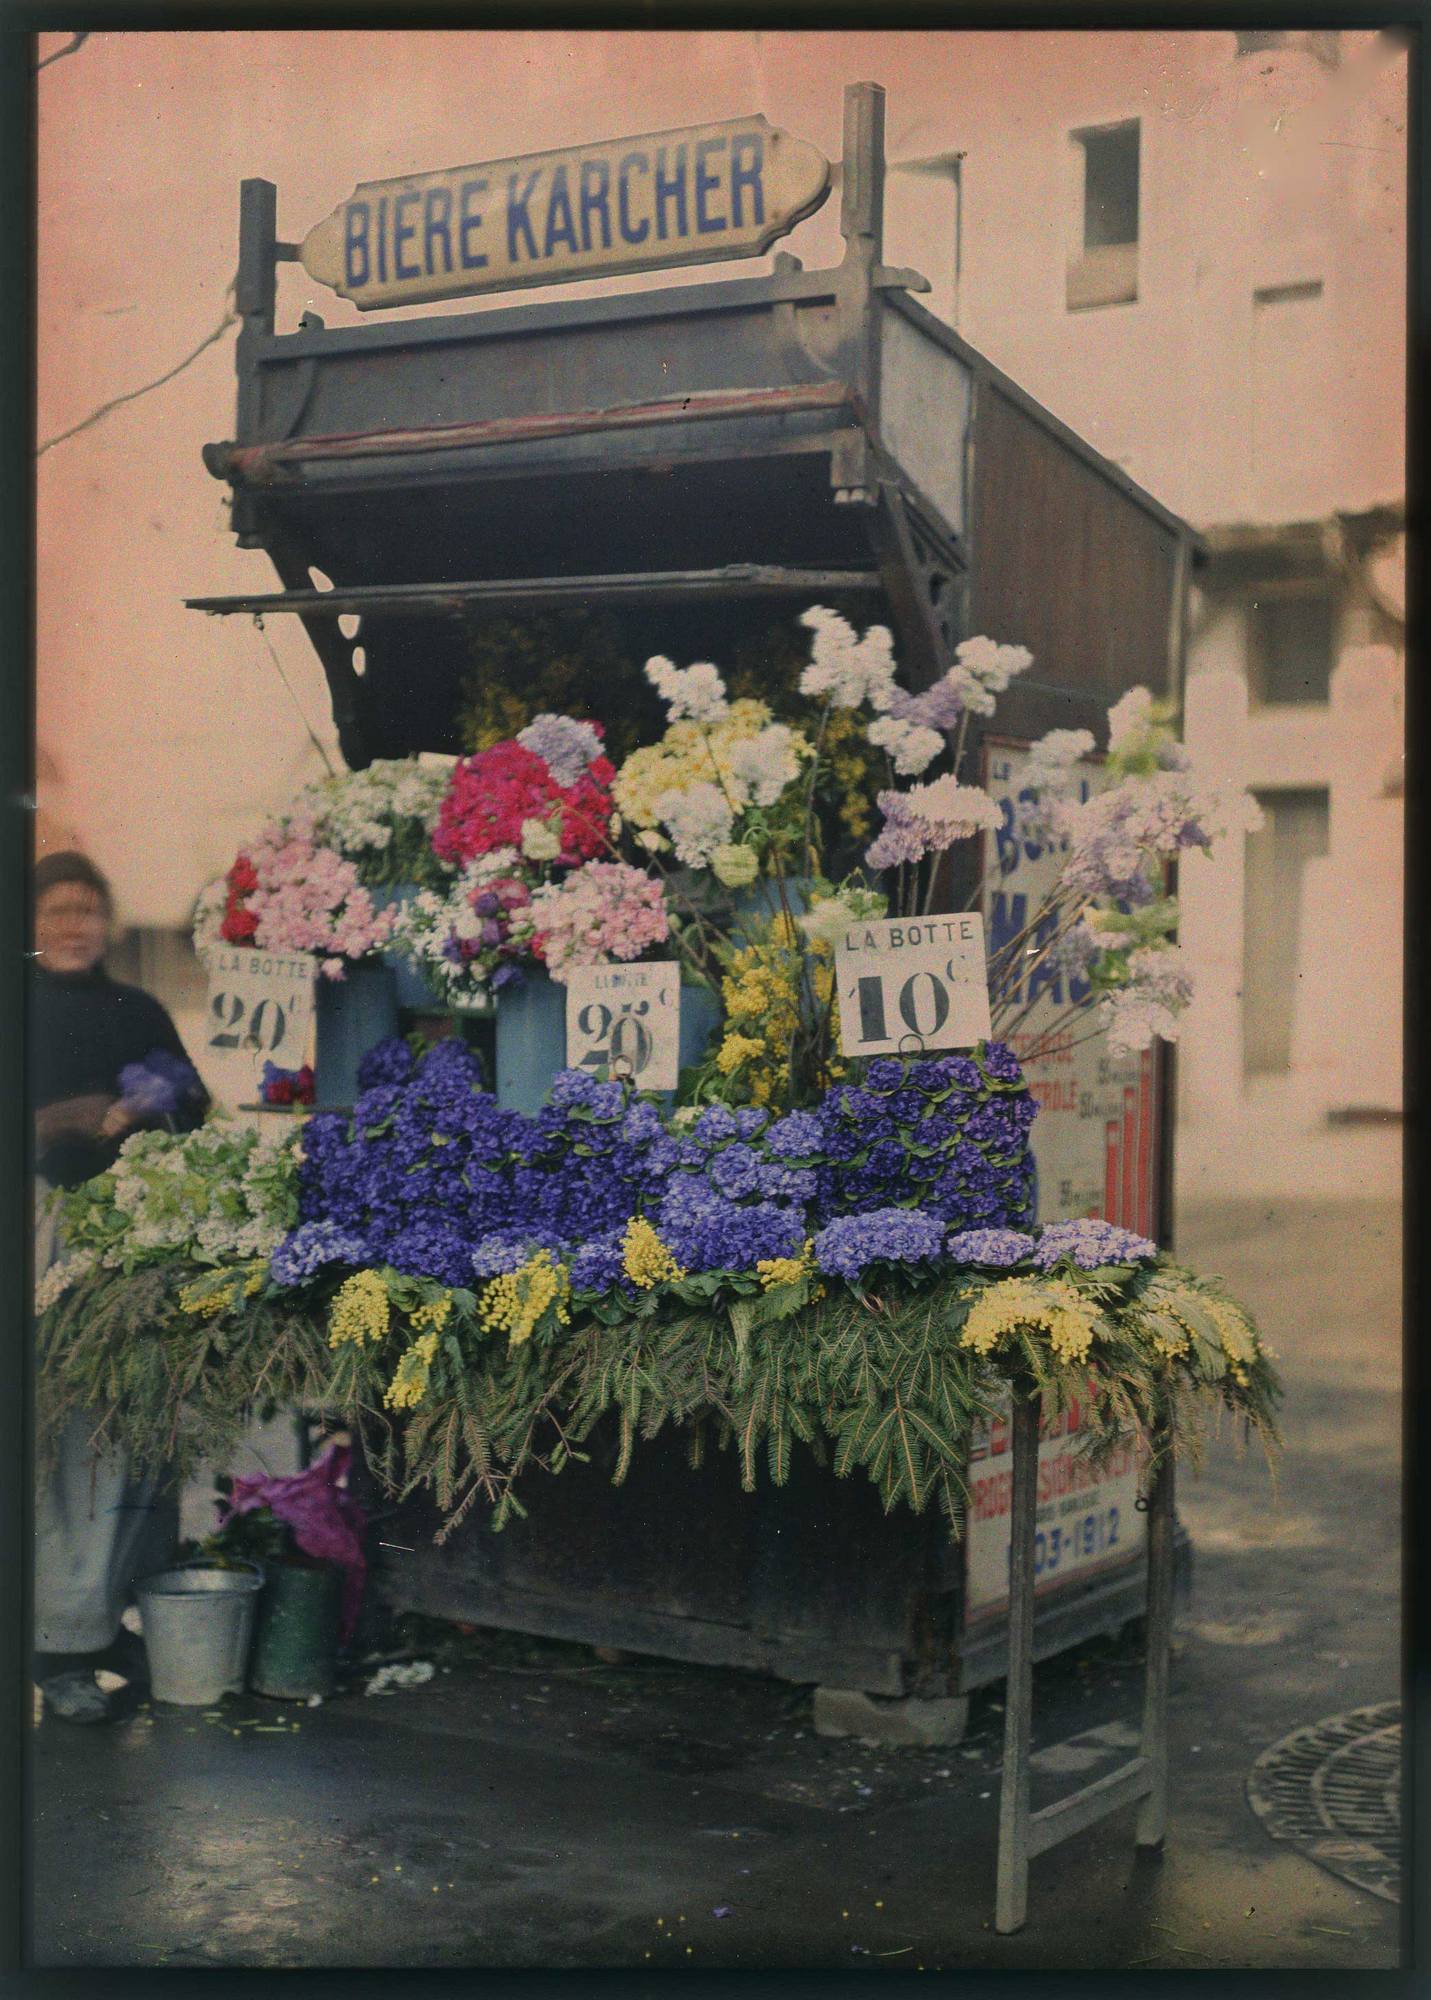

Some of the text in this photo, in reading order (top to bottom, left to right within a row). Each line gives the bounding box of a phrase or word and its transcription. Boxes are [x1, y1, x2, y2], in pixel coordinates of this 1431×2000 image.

[506, 132, 765, 263] KARCHER
[845, 920, 974, 951] LA BOTTE
[219, 955, 307, 978] LA BOTTE
[1008, 1506, 1119, 1574] 03-1912
